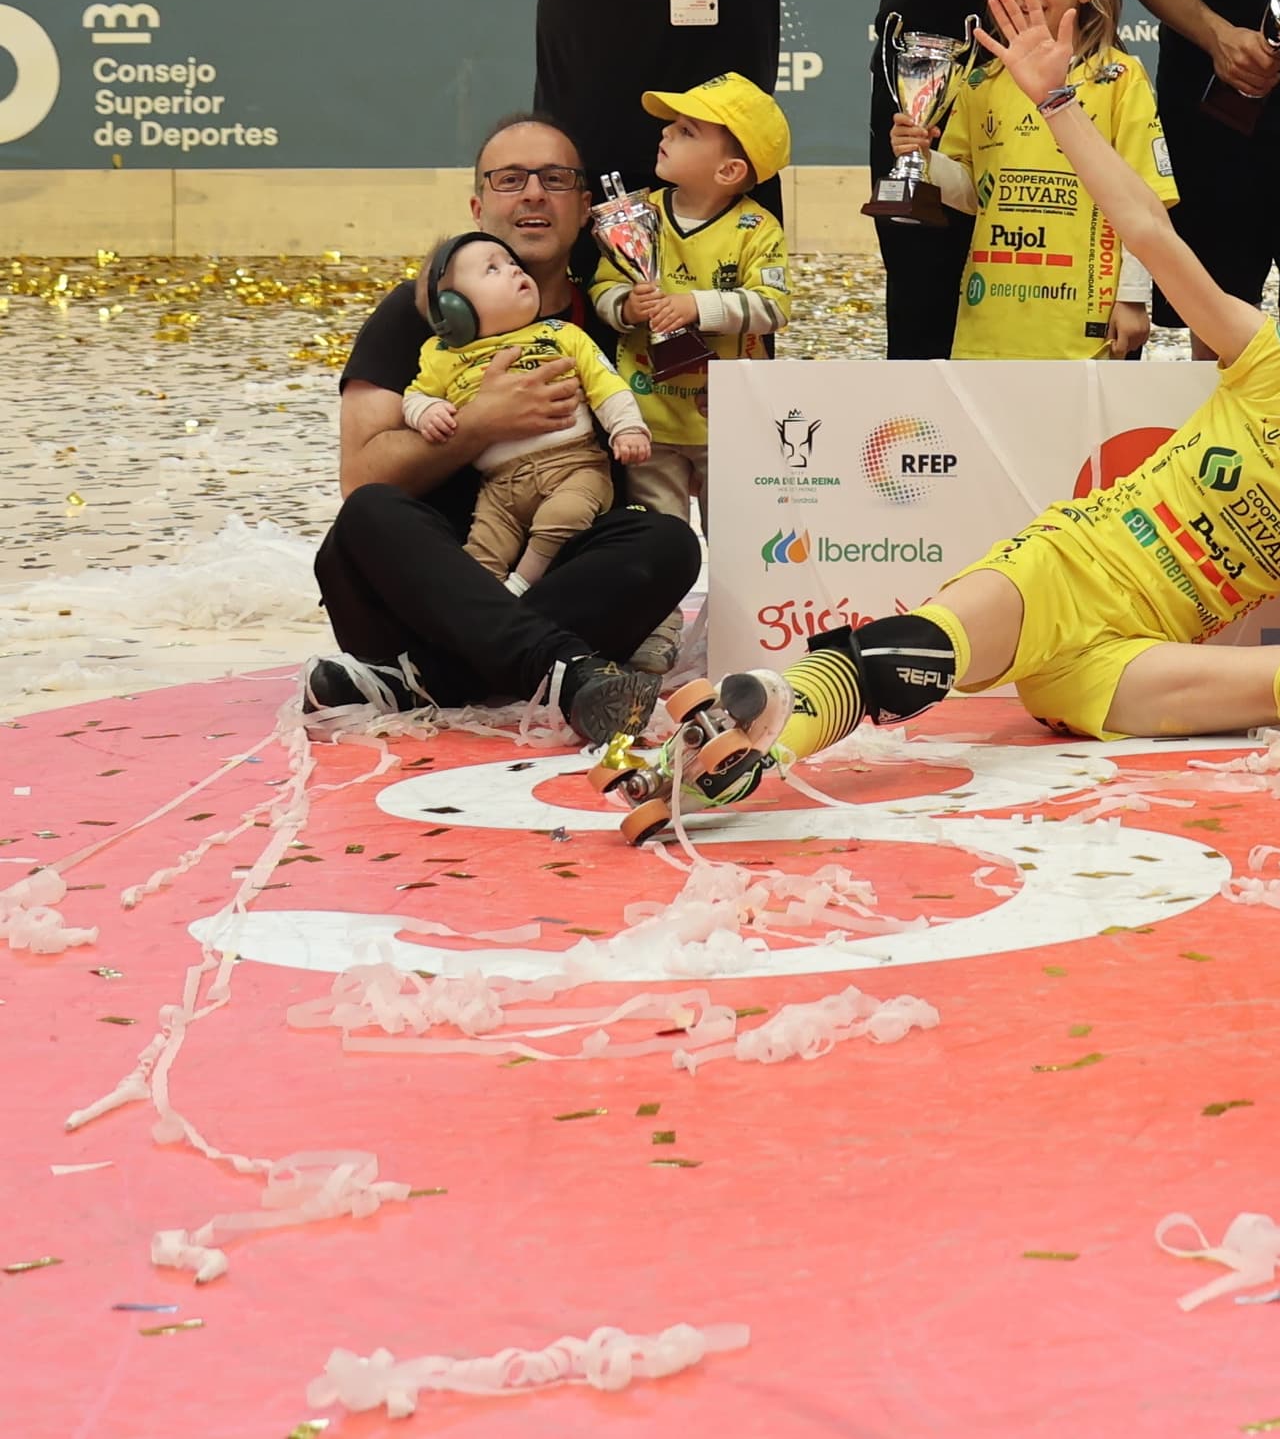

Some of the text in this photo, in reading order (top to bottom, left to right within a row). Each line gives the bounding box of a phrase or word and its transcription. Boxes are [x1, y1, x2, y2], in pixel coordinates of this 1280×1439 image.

[92, 57, 216, 91] Consejo
[94, 88, 225, 121] Superior
[94, 121, 279, 153] de Deportes
[1013, 125, 1040, 133] ALTAN
[998, 173, 1079, 189] COOPERATIVA
[998, 184, 1078, 207] D'IVARS
[990, 224, 1046, 251] Pujol
[666, 271, 698, 283] ALTAN
[990, 282, 1077, 303] energianufri
[901, 453, 958, 474] RFEP
[754, 476, 781, 487] COPA
[796, 476, 810, 487] LA
[811, 476, 842, 487] REINA
[817, 537, 944, 563] Iberdrola
